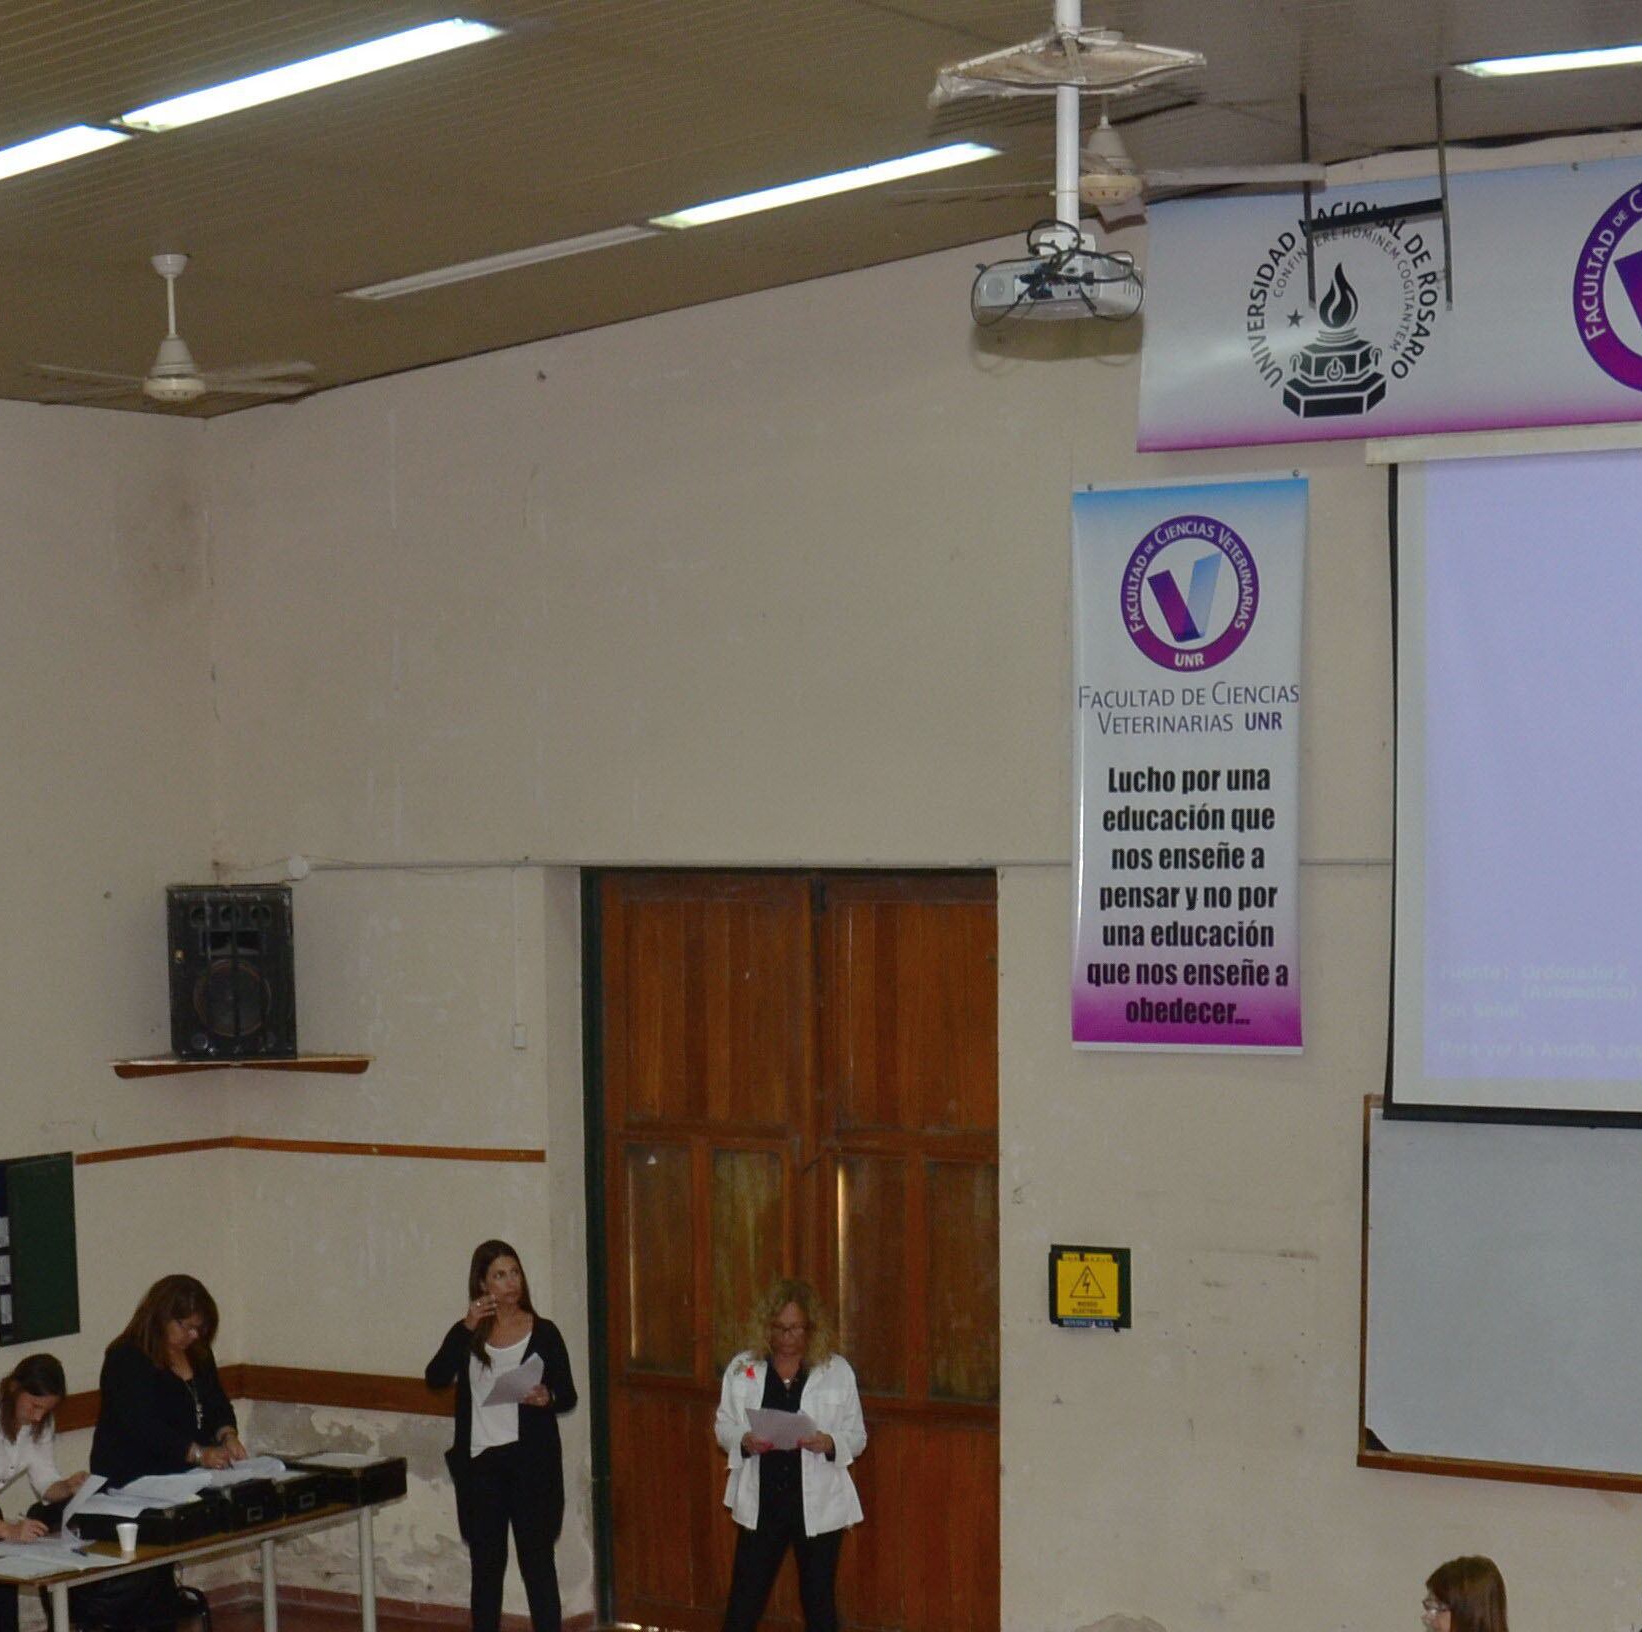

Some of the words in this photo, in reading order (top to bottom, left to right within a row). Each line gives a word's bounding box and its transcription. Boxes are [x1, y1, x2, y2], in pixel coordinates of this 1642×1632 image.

[1274, 230, 1342, 298] CONFINERE
[1404, 234, 1431, 268] DE
[1582, 229, 1615, 341] FACULTAD
[1612, 210, 1629, 227] DE
[1247, 231, 1296, 388] UNIVERSIDAD
[1391, 270, 1438, 380] ROSARIO
[1127, 557, 1149, 634] FACULTAD
[1154, 523, 1215, 545] CIENCIAS
[1215, 526, 1254, 631] VETERINARIAS
[1174, 652, 1205, 668] UNR
[1078, 685, 1175, 709] FACULTAD
[1181, 688, 1206, 707] DE
[1211, 681, 1301, 707] CIENCIAS
[1097, 711, 1233, 736] VETERINARIAS
[1245, 712, 1282, 733] UNR
[1108, 765, 1177, 795] Lucho
[1181, 770, 1221, 796] por
[1226, 766, 1271, 792] una
[1102, 802, 1226, 833] educación
[1231, 807, 1275, 834] que
[1112, 847, 1153, 871] nos
[1159, 841, 1246, 871] enseñe
[1250, 846, 1265, 870] a
[1099, 883, 1181, 911] pensar
[1186, 883, 1198, 910] y
[1203, 883, 1233, 909] no
[1238, 882, 1278, 911] por
[1102, 924, 1146, 948] una
[1150, 917, 1274, 948] educación
[1087, 962, 1130, 989] que
[1135, 961, 1179, 986] nos
[1183, 954, 1270, 987] enseñe
[1275, 962, 1289, 986] a
[1126, 998, 1250, 1026] obedecer...
